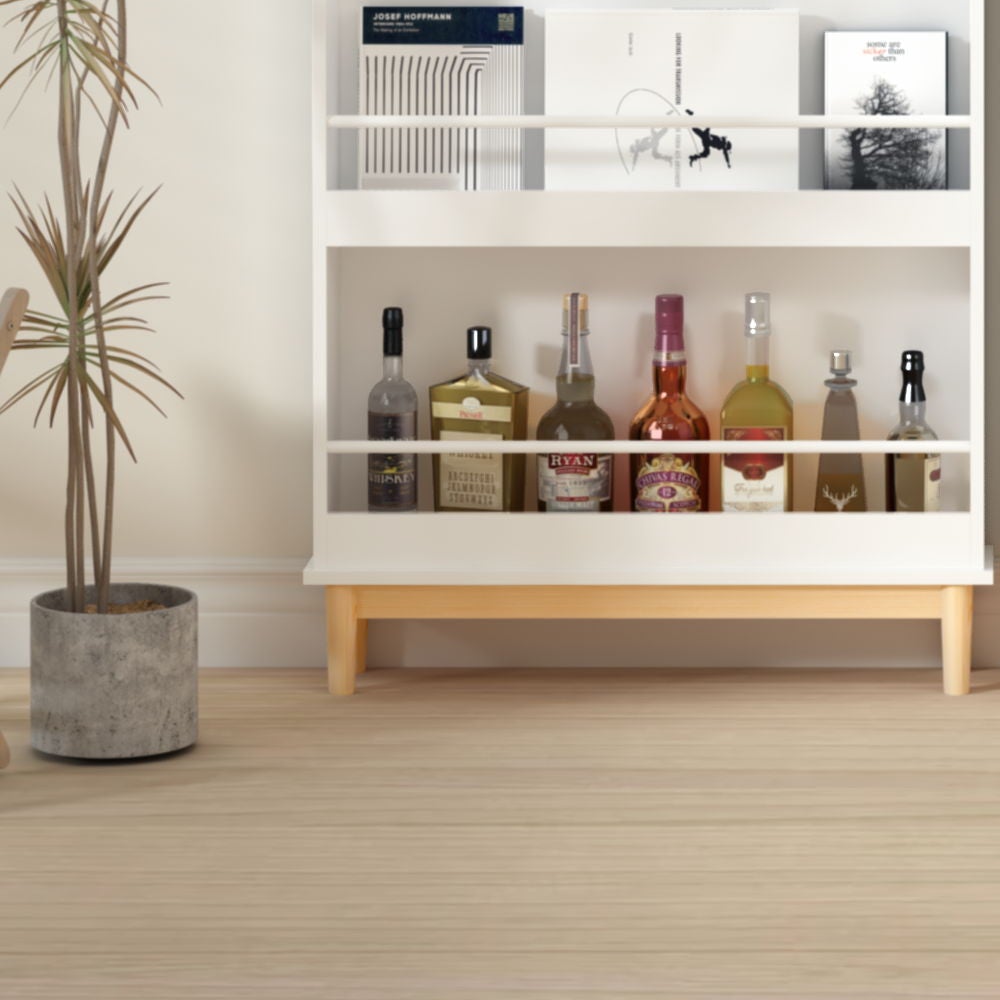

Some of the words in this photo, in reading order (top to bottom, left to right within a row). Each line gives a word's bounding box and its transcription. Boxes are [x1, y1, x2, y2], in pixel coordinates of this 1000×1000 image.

[373, 13, 401, 21] JOSEF
[404, 13, 452, 21] HOFFMANN
[551, 454, 594, 467] RYAN
[638, 473, 669, 488] CHIVAS
[670, 473, 699, 488] REGAL
